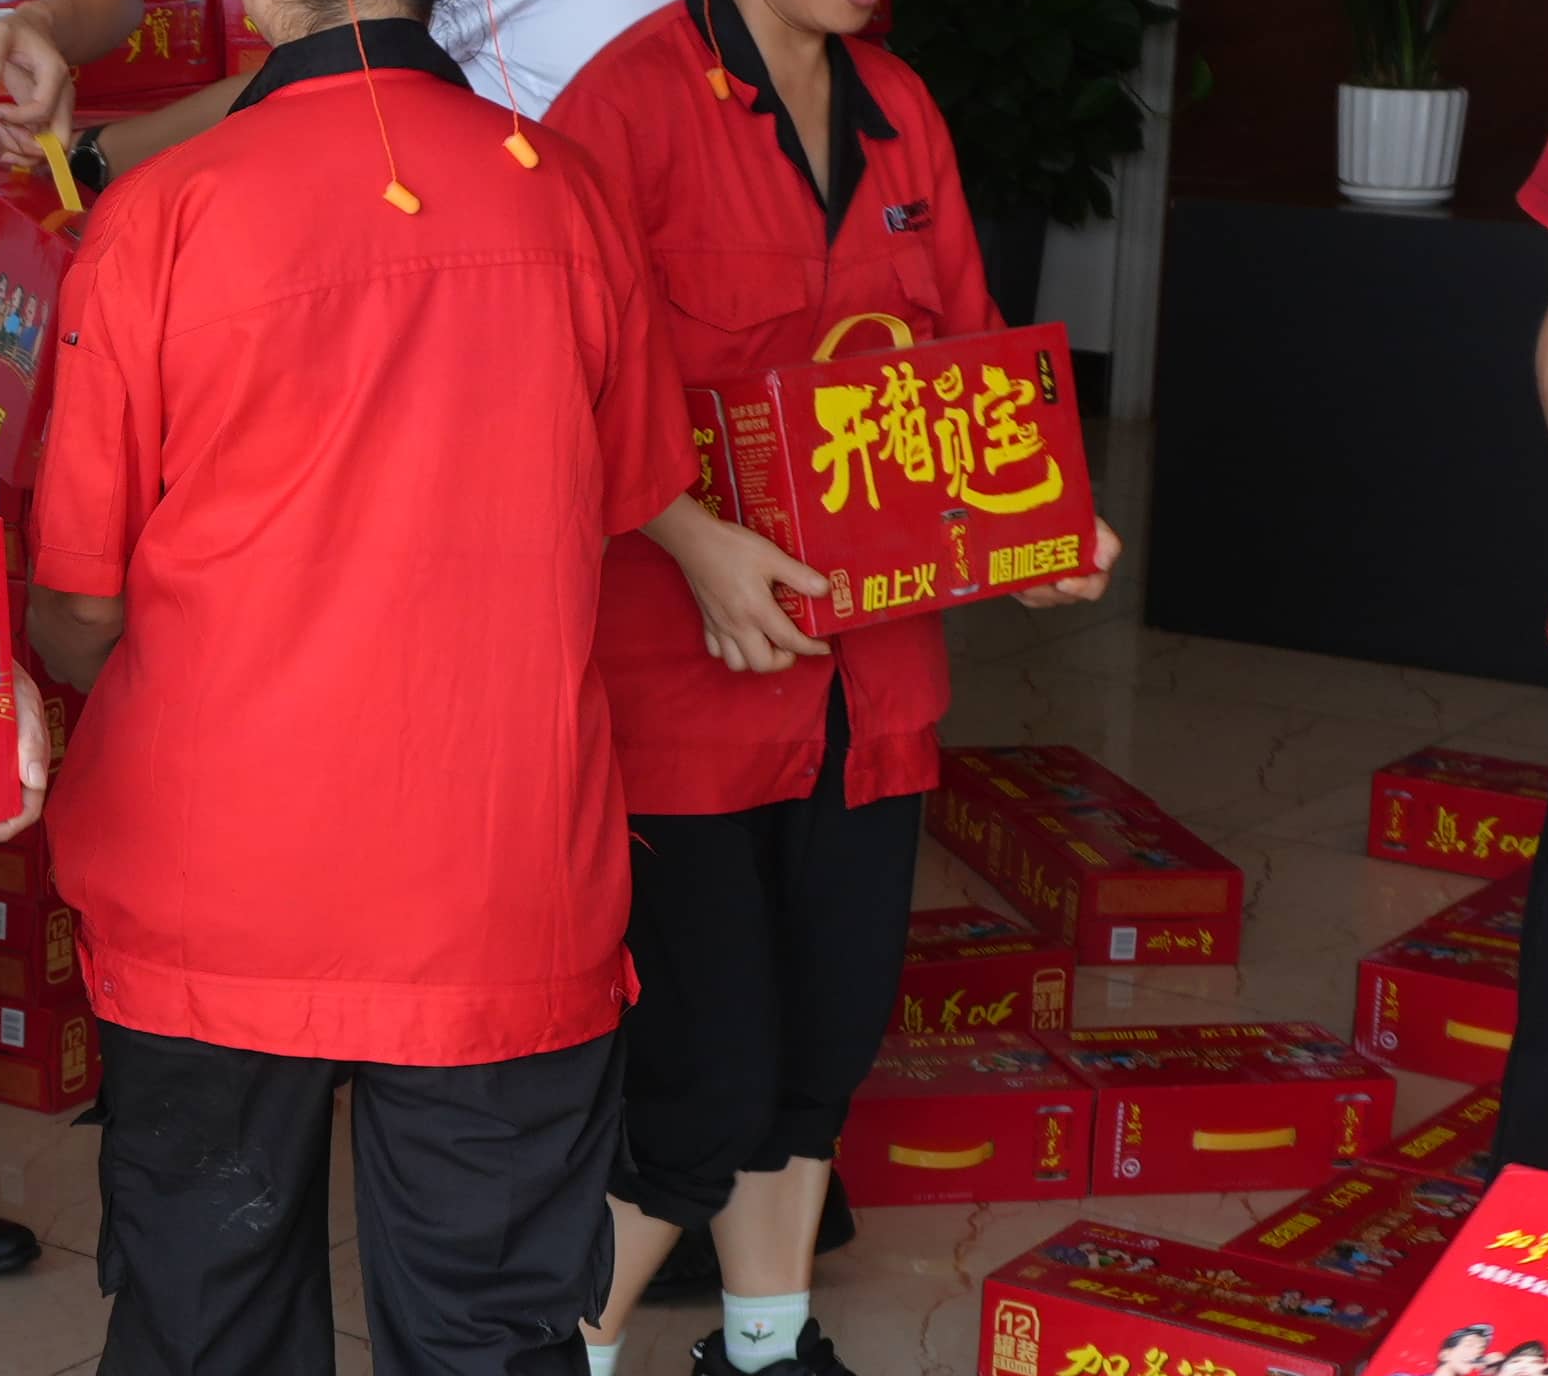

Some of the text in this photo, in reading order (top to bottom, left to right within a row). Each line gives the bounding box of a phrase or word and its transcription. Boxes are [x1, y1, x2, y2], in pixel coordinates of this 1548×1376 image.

[862, 562, 937, 613] 怕上火
[988, 533, 1080, 586] 喝加多宝
[1000, 1311, 1030, 1338] 12
[992, 1332, 1039, 1365] 罐装
